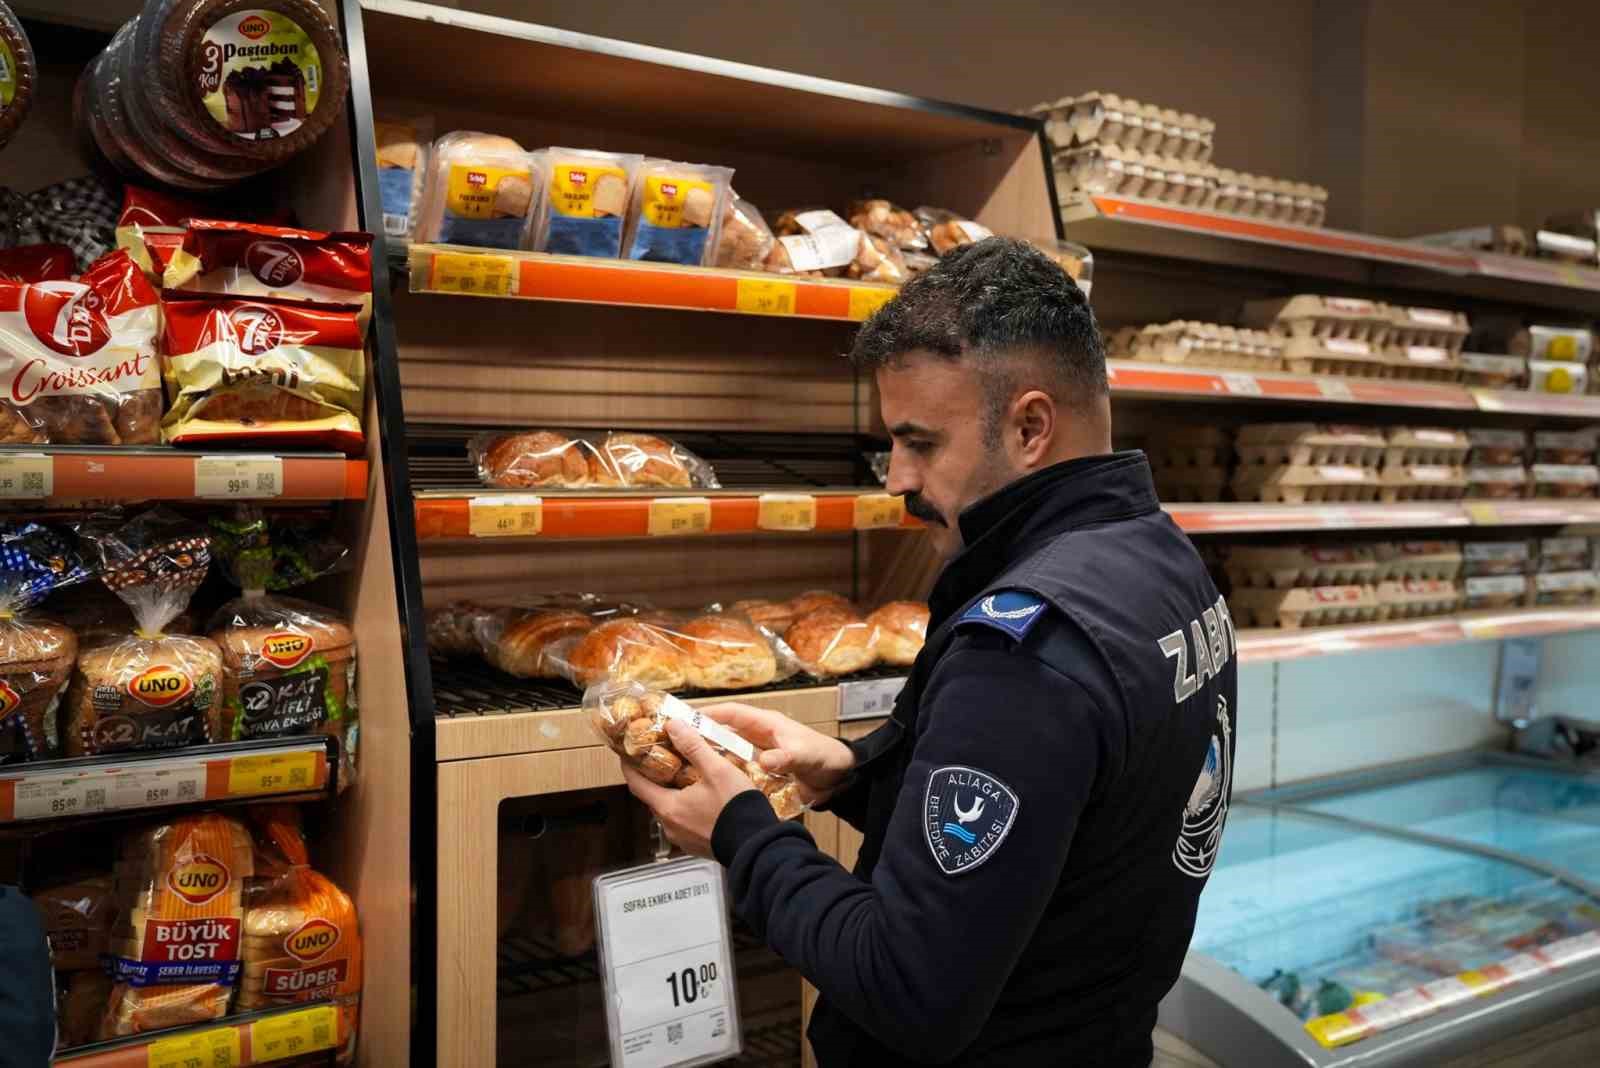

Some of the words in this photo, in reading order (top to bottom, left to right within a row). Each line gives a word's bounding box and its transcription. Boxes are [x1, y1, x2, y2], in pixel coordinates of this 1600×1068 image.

[242, 22, 265, 33] UNO
[202, 45, 219, 73] 3
[223, 41, 299, 62] Pastaban
[256, 244, 290, 281] 7
[31, 280, 92, 347] 7
[233, 310, 267, 351] 7
[11, 351, 151, 402] Croissant
[138, 677, 182, 693] UNO
[178, 872, 219, 888] UNO
[623, 897, 647, 914] SOFRA
[155, 919, 232, 942] BÜYÜK
[294, 931, 331, 950] UNO
[165, 942, 220, 961] TOST
[275, 966, 338, 992] SÜPER
